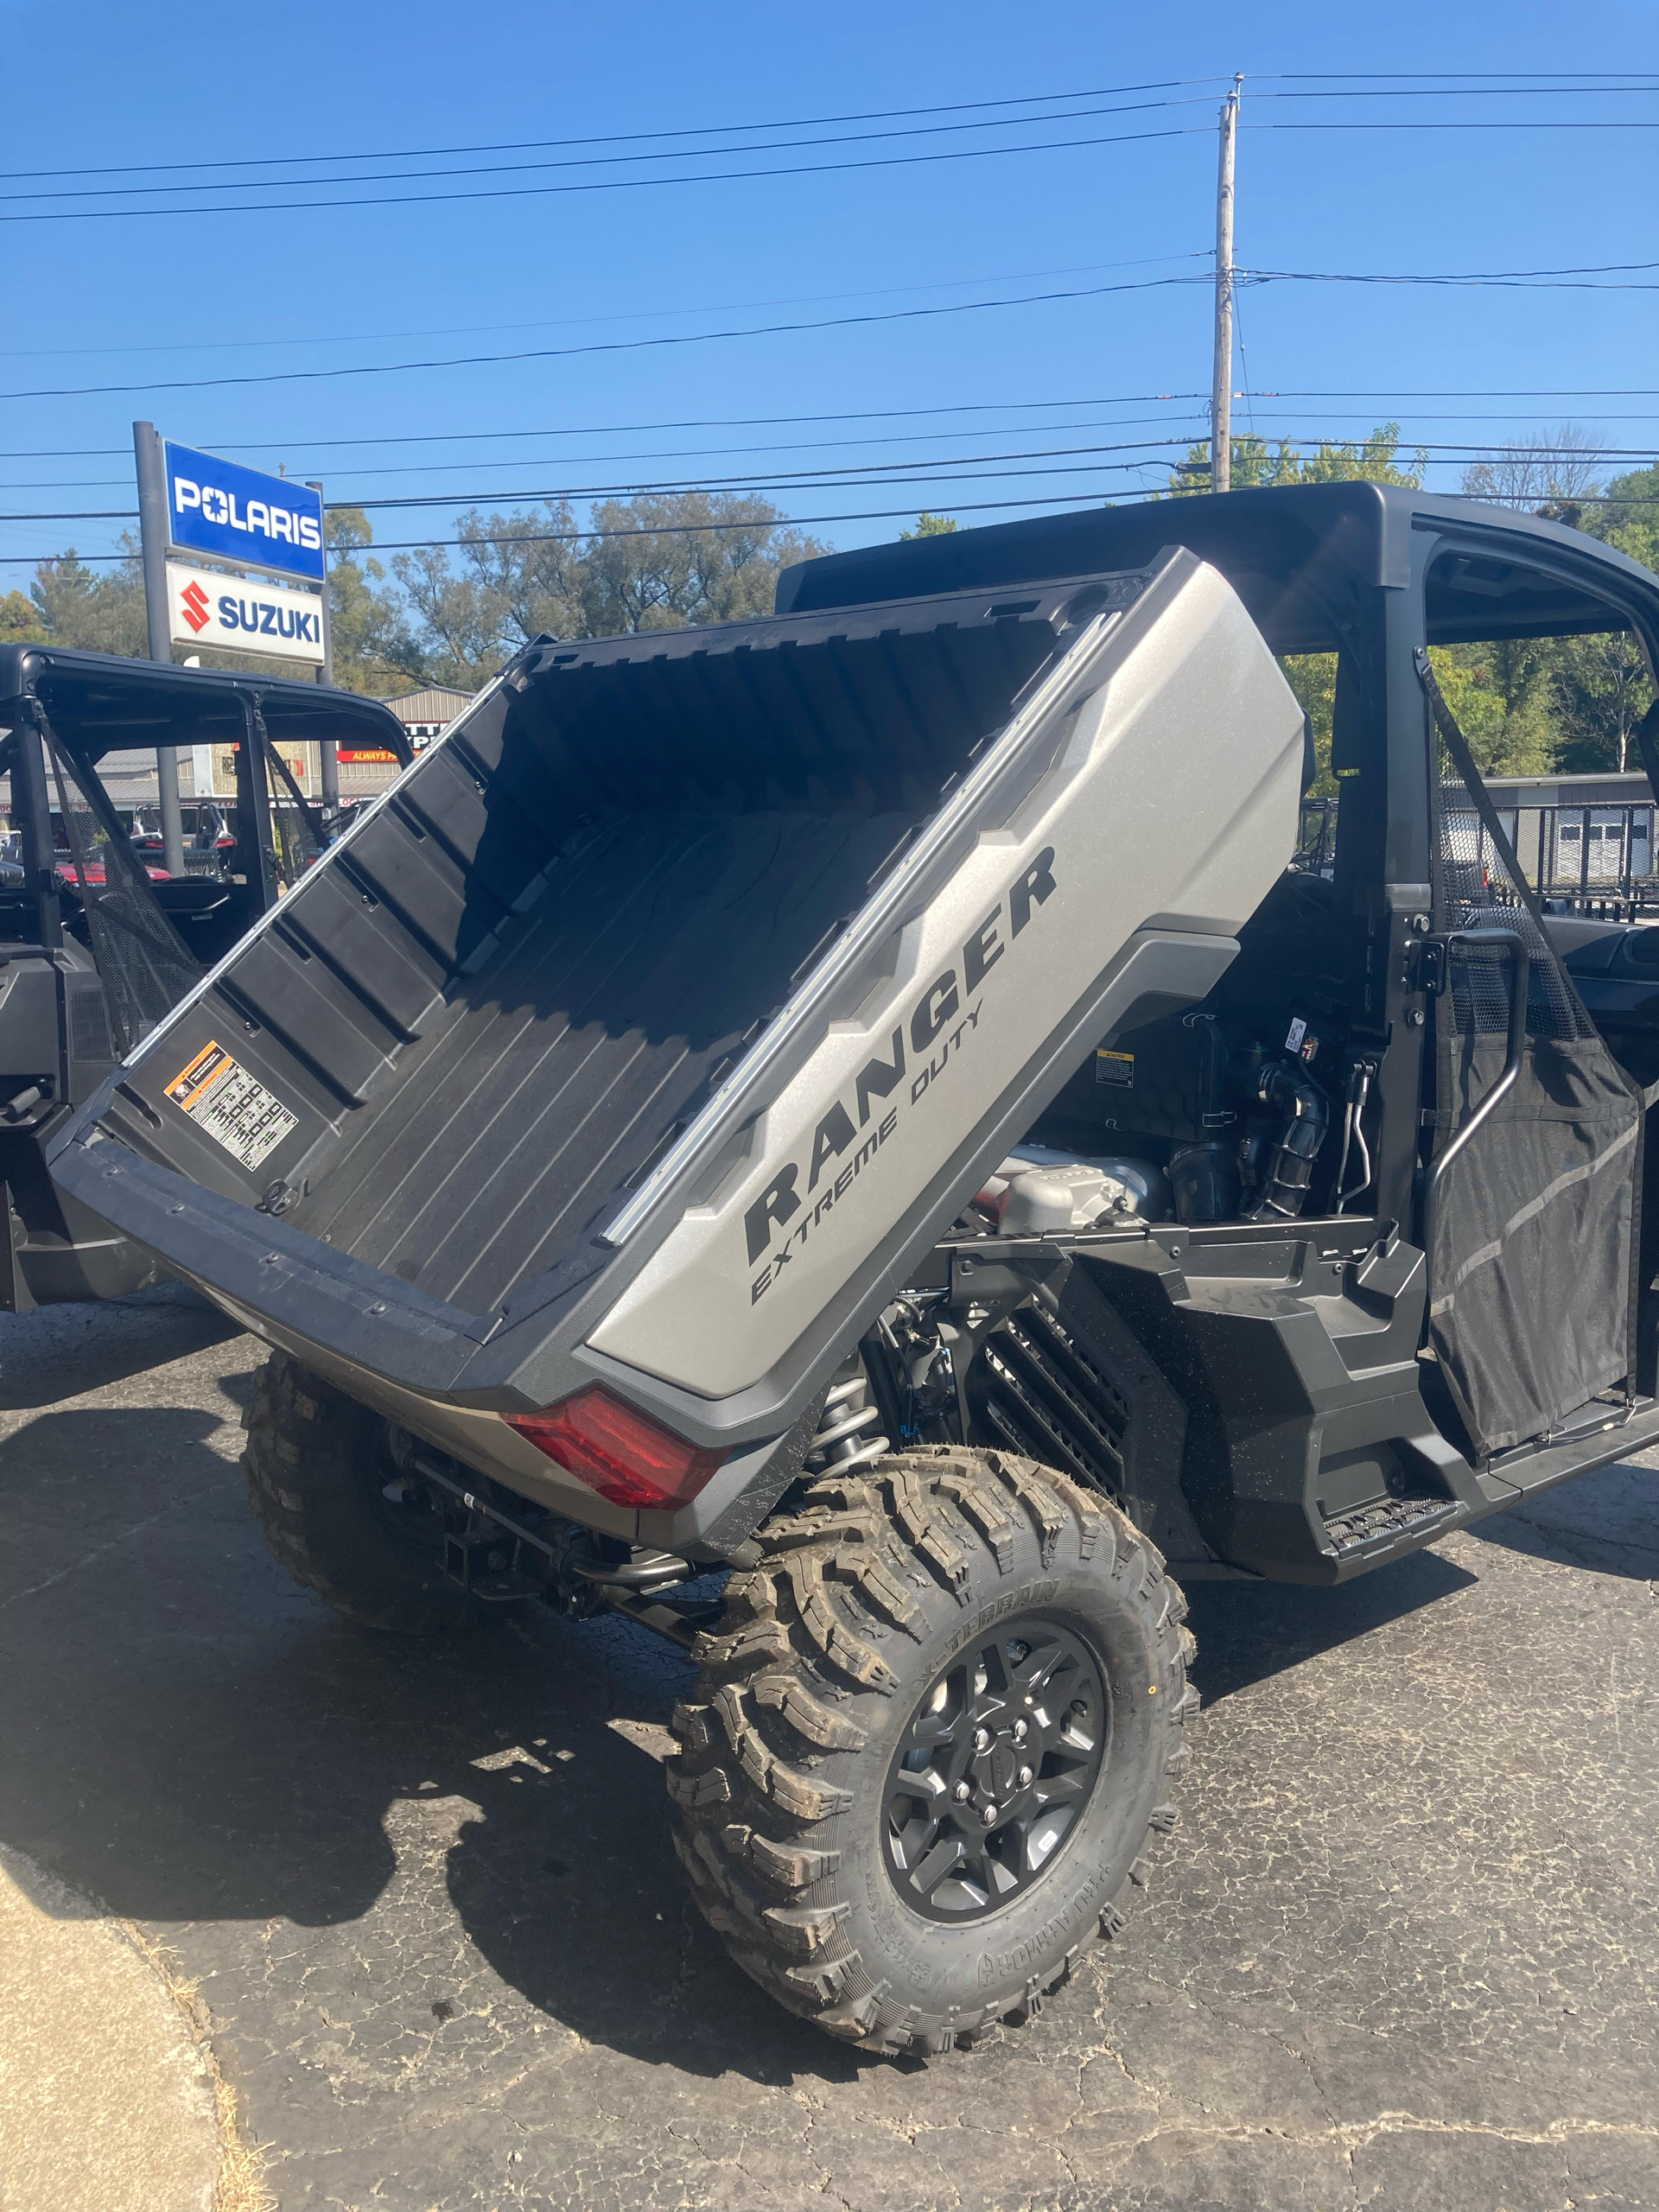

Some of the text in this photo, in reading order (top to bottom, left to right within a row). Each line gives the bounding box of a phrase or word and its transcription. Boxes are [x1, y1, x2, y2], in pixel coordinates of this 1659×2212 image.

[174, 476, 321, 550] POLARIS
[218, 595, 321, 644] SUZUKI
[353, 752, 385, 760] ALWAYS
[184, 1058, 201, 1075] WARNING
[744, 846, 1057, 1267] RANGER
[200, 1073, 218, 1090] WARNING
[751, 998, 983, 1306] EXTREME DUTY
